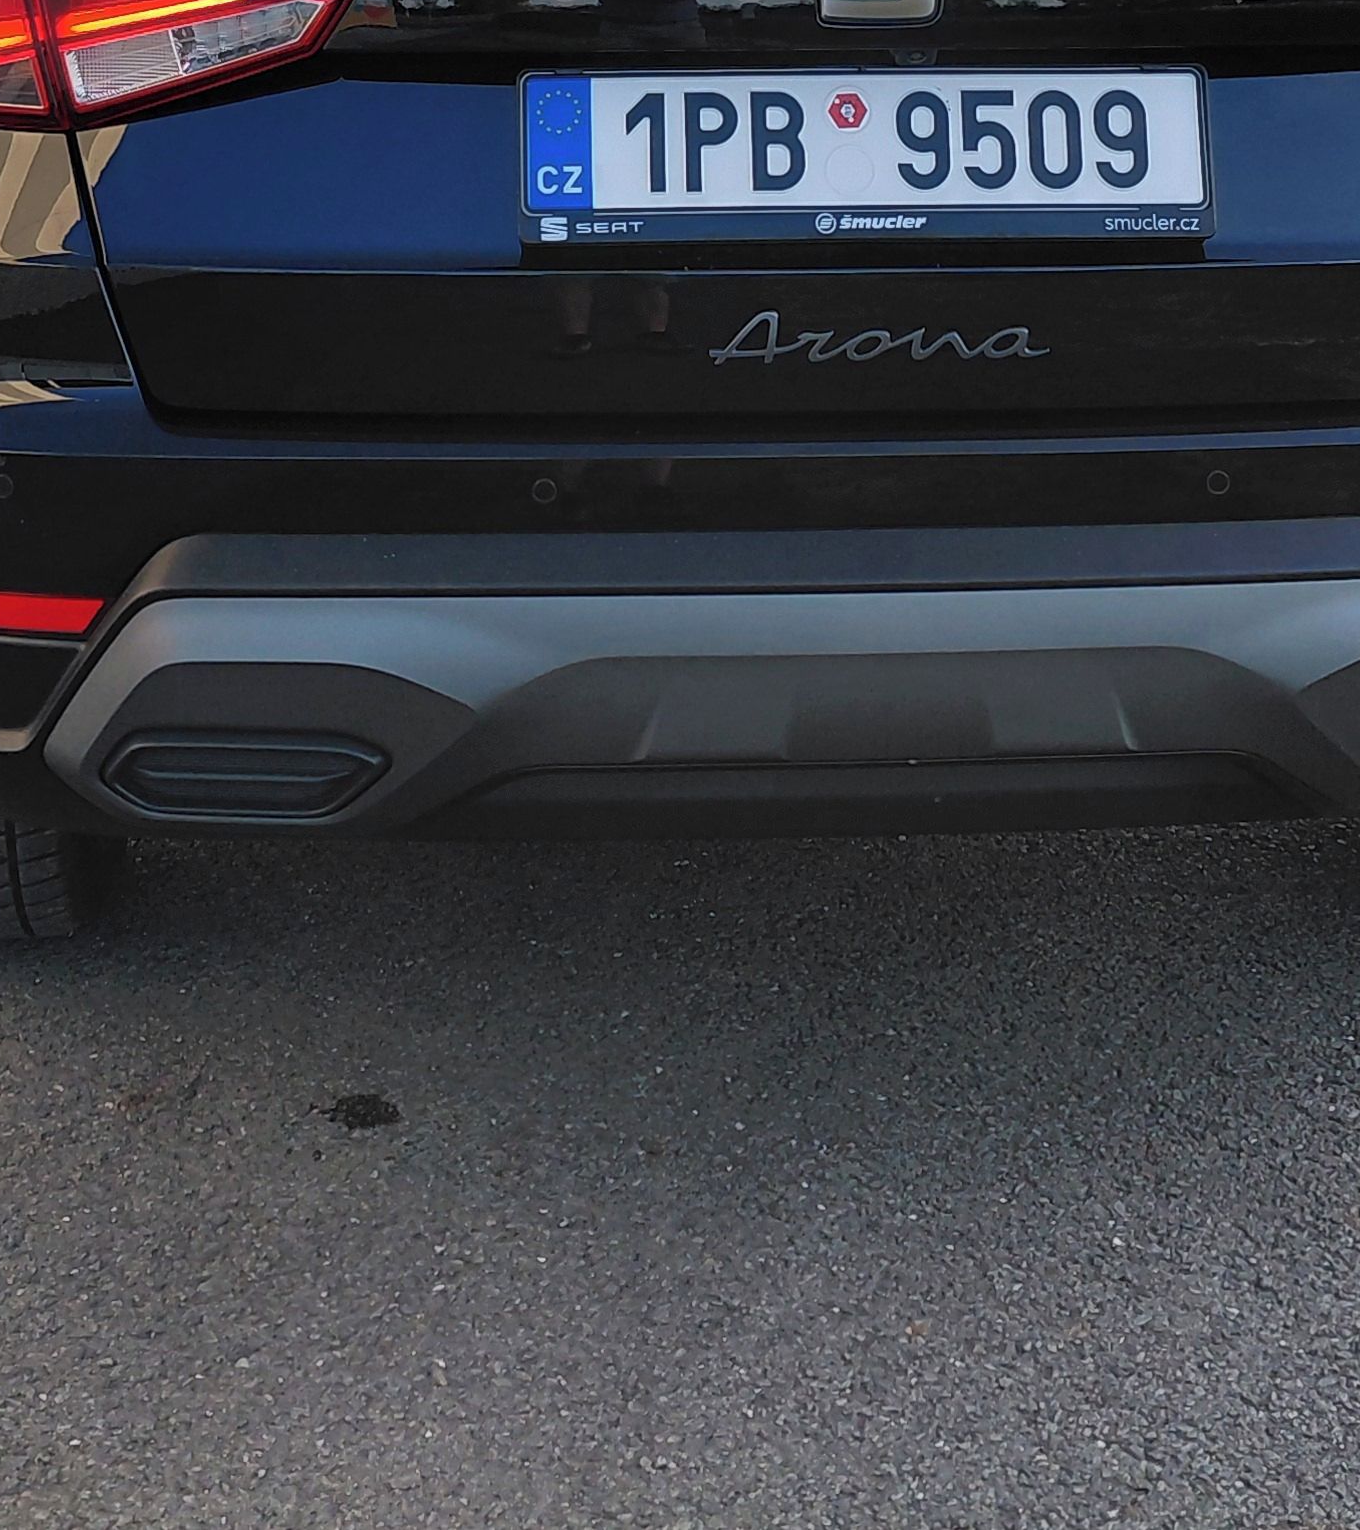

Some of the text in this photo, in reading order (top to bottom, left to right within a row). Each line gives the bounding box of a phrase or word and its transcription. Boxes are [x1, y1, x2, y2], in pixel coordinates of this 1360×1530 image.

[625, 89, 1150, 194] 1PB 9509
[537, 165, 583, 195] CZ
[575, 220, 645, 235] SEAT
[839, 214, 927, 231] šmucler
[1104, 213, 1200, 232] smucler.cz
[708, 309, 1051, 365] Arona
